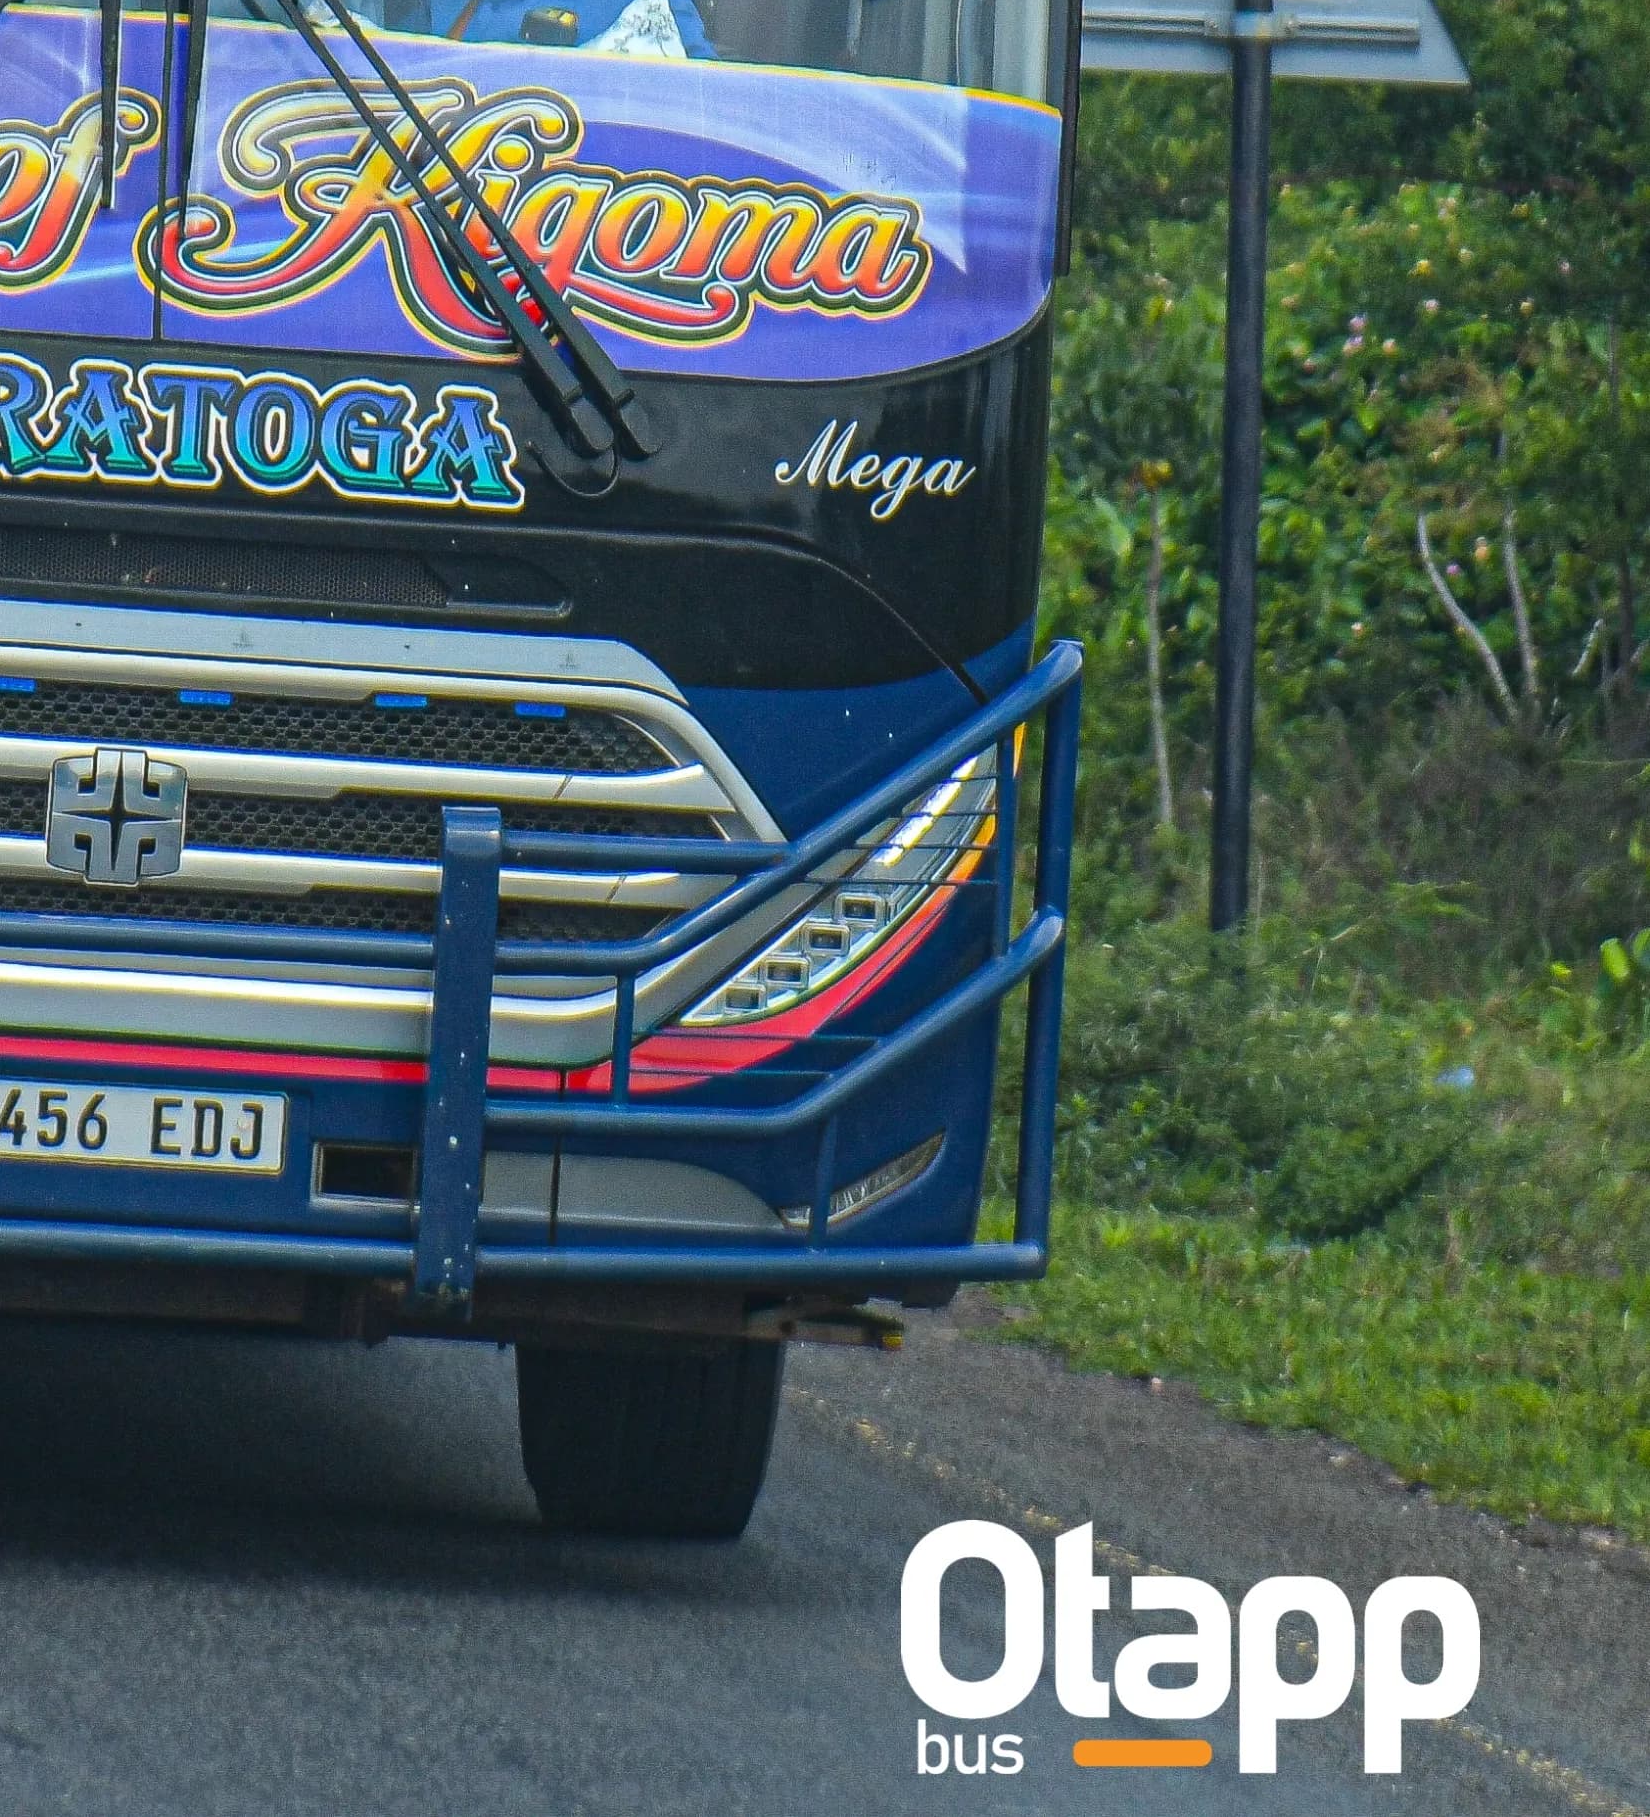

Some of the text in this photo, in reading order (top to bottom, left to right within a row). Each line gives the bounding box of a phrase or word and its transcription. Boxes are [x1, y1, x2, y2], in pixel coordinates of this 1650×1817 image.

[133, 77, 933, 363] Kigoma
[774, 418, 977, 522] Mega
[151, 1096, 264, 1159] EDJ
